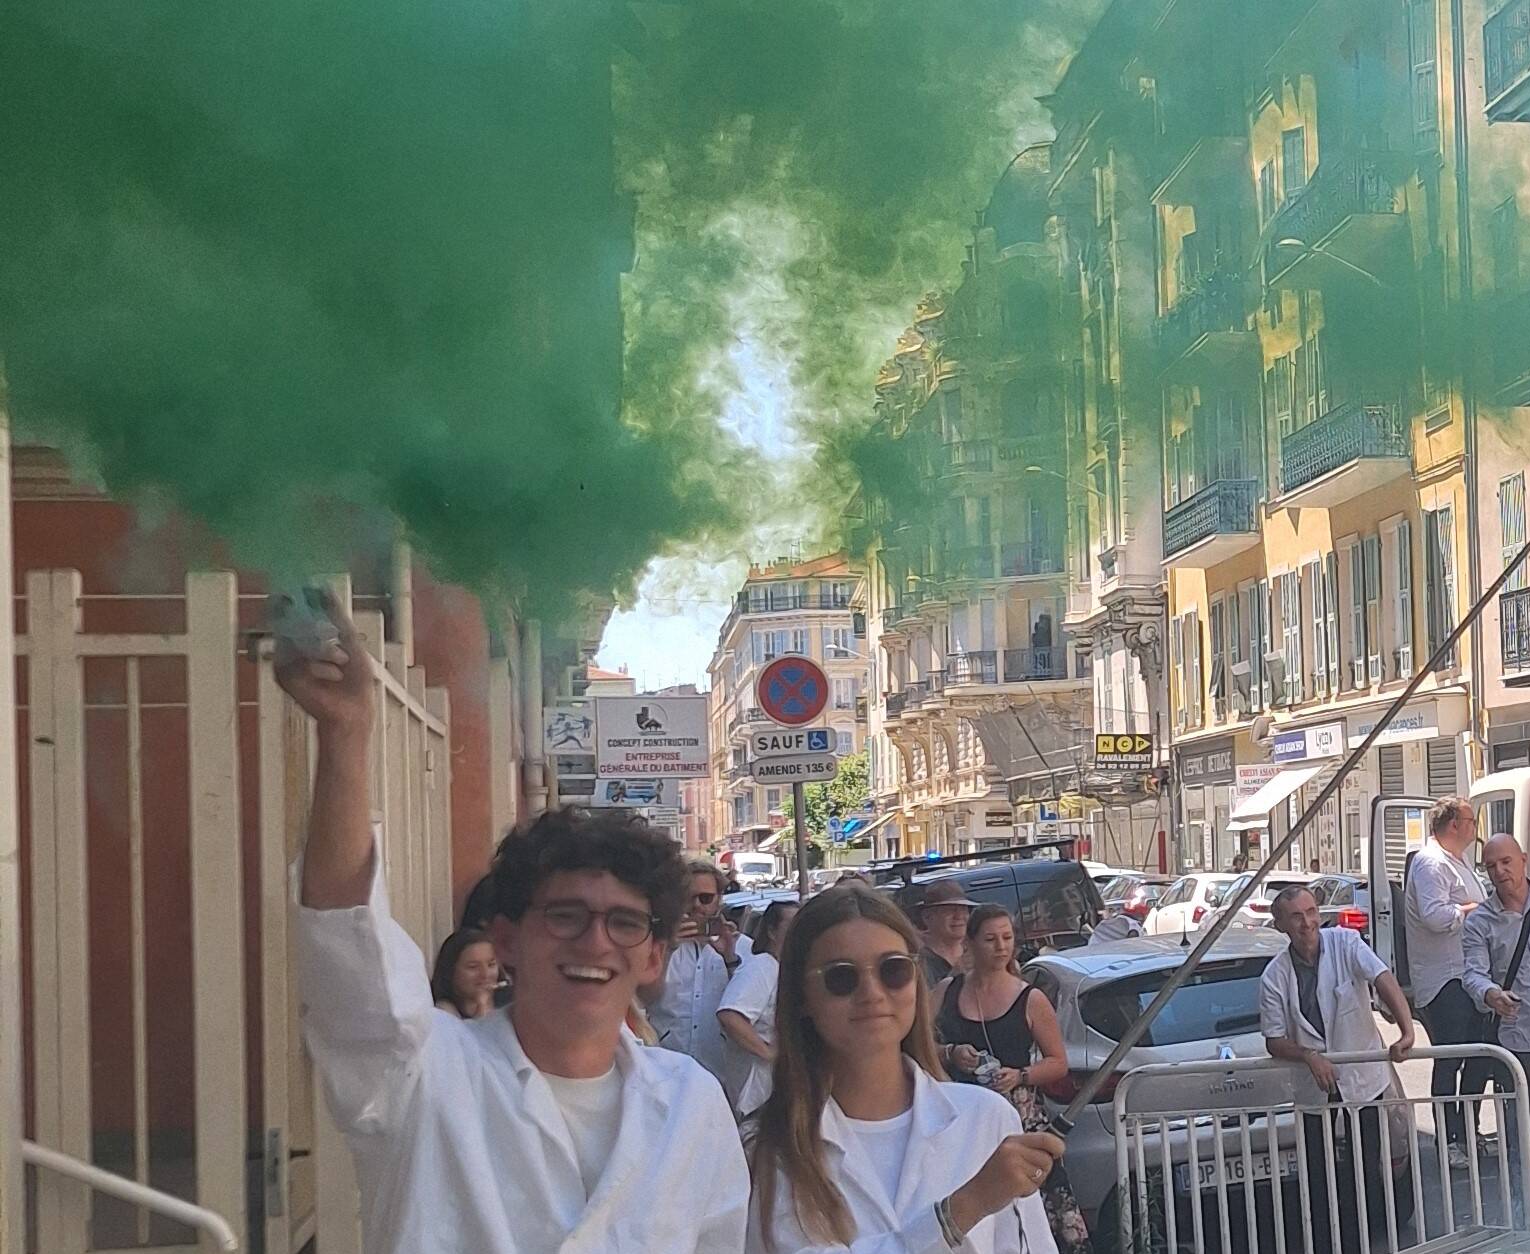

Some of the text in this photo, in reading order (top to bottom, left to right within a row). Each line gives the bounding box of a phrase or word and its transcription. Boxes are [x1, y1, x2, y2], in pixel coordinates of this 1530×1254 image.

[608, 737, 699, 747] CONCEPT CONSTRUCTION
[757, 734, 804, 751] SAUF
[625, 752, 681, 761] ENTREPRISE
[1096, 753, 1152, 761] RAVALEMENT
[649, 763, 662, 772] DU
[758, 762, 834, 776] AMENDE 135 €
